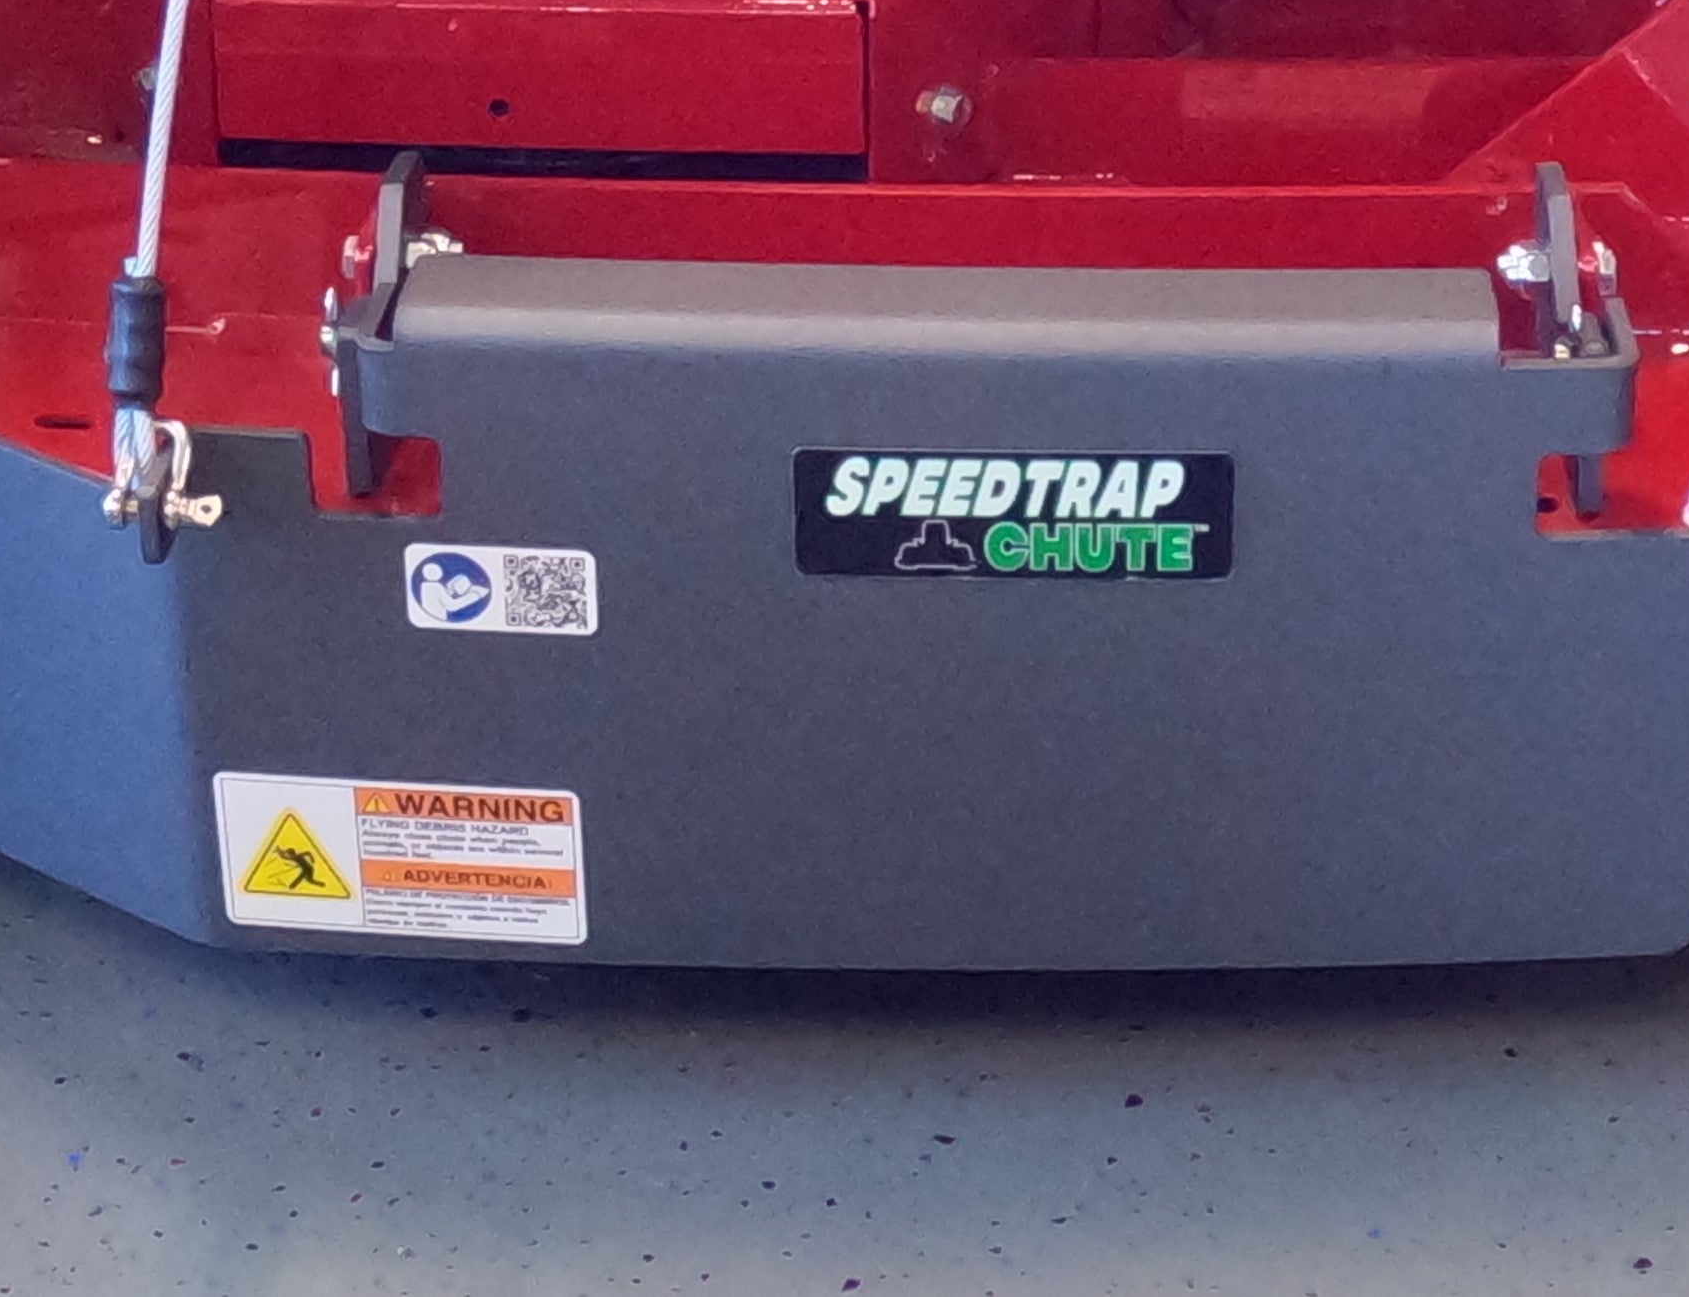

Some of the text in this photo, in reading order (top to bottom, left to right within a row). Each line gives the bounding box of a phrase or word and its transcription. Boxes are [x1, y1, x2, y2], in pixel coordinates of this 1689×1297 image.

[825, 456, 1185, 519] SPEEDTRAP
[983, 522, 1194, 573] CHUTE
[395, 793, 564, 822] WARNING
[404, 869, 547, 890] ADVERTENCIA
